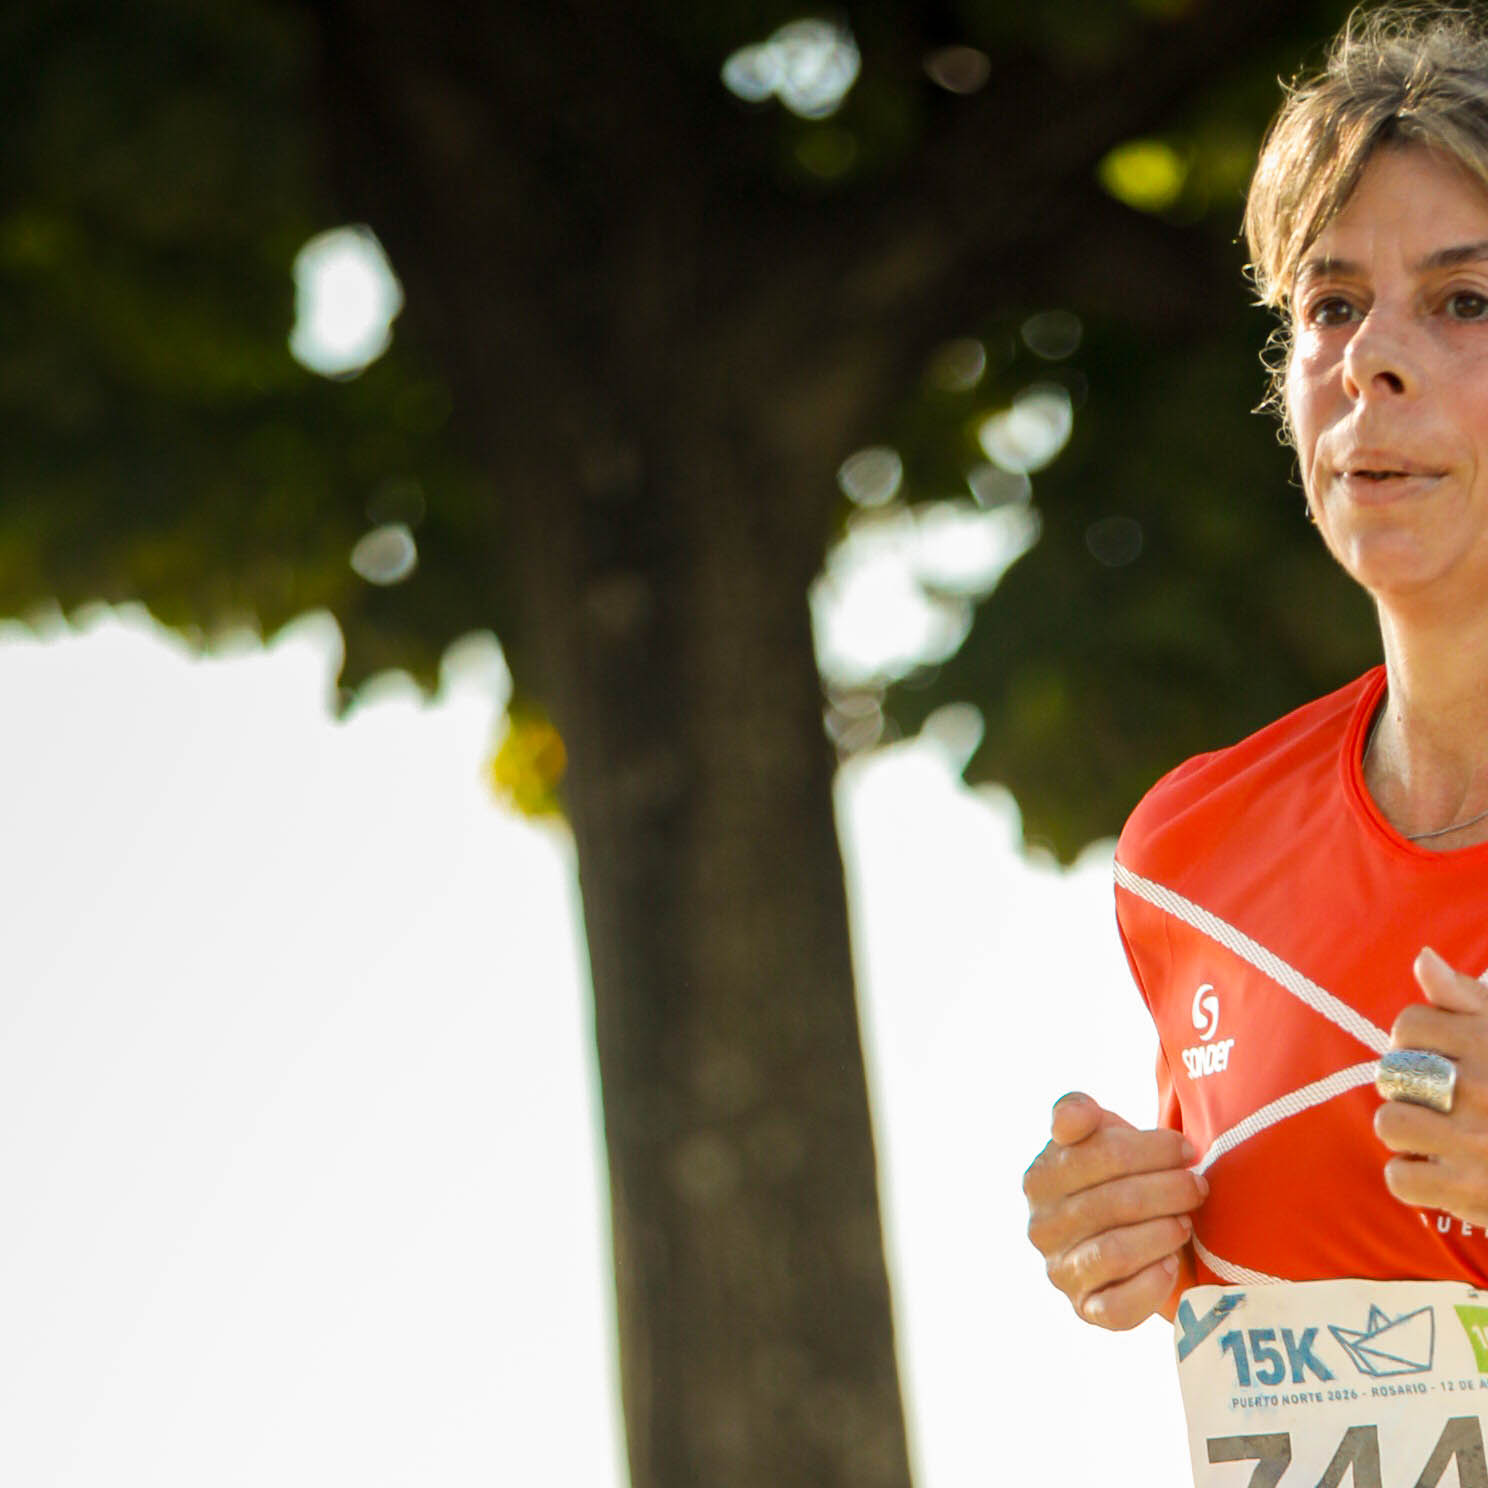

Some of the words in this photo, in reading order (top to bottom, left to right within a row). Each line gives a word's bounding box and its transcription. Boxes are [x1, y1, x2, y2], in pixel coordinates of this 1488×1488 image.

[1221, 1327, 1337, 1388] 15K
[1232, 1395, 1278, 1408] PUERTO
[1282, 1391, 1323, 1406] NORTE
[1327, 1389, 1358, 1401] 2026
[1371, 1383, 1427, 1398] ROSARIO
[1440, 1381, 1454, 1391] 12
[1459, 1379, 1474, 1390] DE
